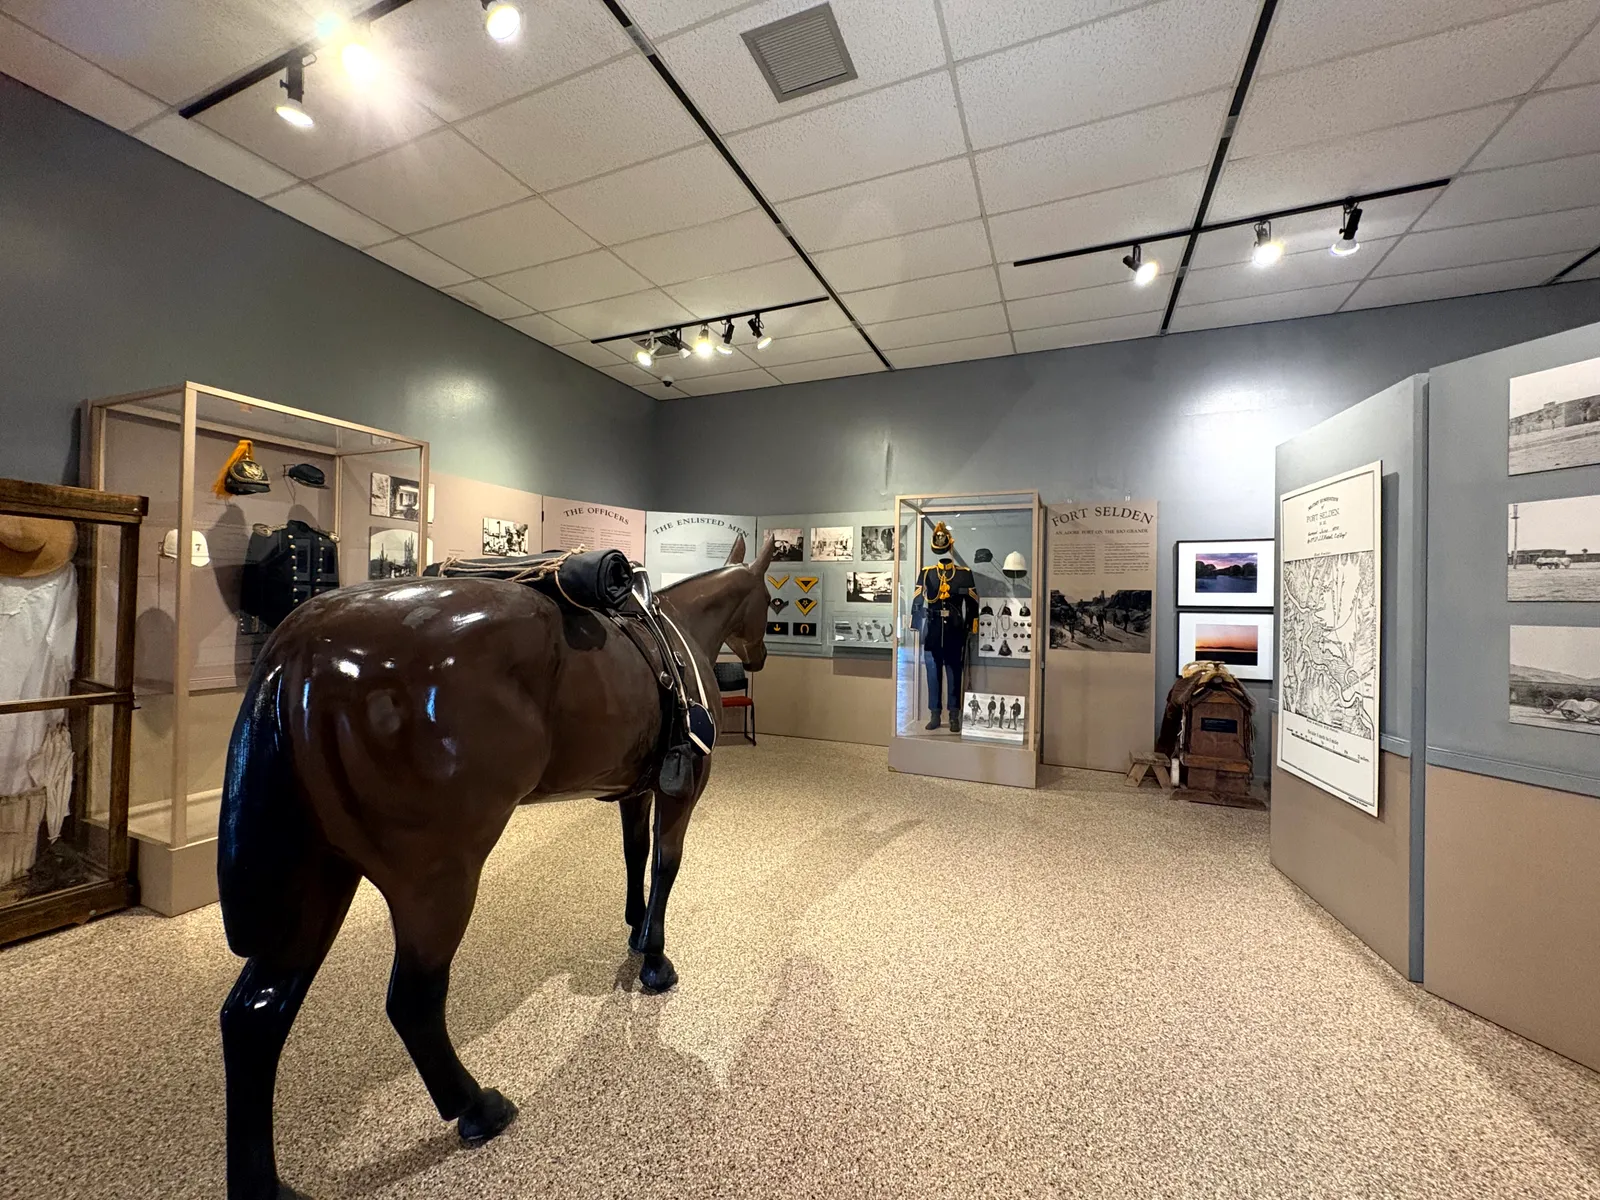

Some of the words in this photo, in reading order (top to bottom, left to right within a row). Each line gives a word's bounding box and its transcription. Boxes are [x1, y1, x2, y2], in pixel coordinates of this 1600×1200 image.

[563, 508, 584, 517] THE
[587, 507, 629, 525] OFFICERS
[1051, 508, 1088, 527] FORT
[1094, 506, 1154, 525] SELDEN
[653, 522, 673, 535] THE
[677, 517, 725, 527] ENLISTED
[728, 523, 749, 538] MEN
[195, 543, 202, 551] 7
